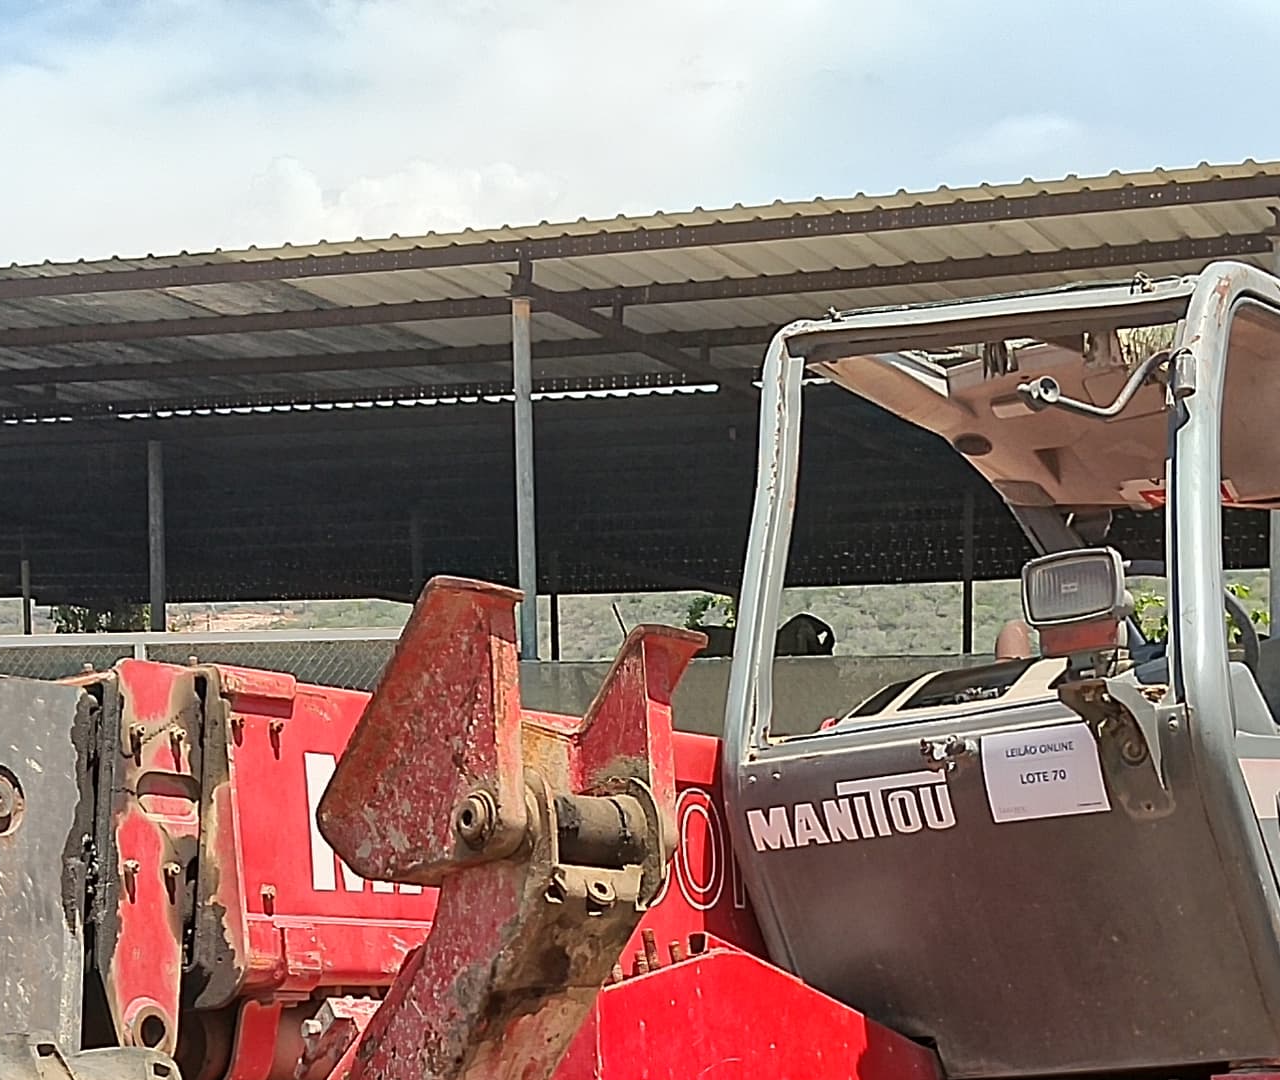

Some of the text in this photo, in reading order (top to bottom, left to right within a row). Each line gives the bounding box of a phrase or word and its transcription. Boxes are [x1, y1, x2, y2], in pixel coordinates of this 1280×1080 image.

[1006, 741, 1074, 758] LEILÃO ONLINE
[1020, 769, 1067, 785] LOTE 70
[746, 769, 956, 852] MANITOU
